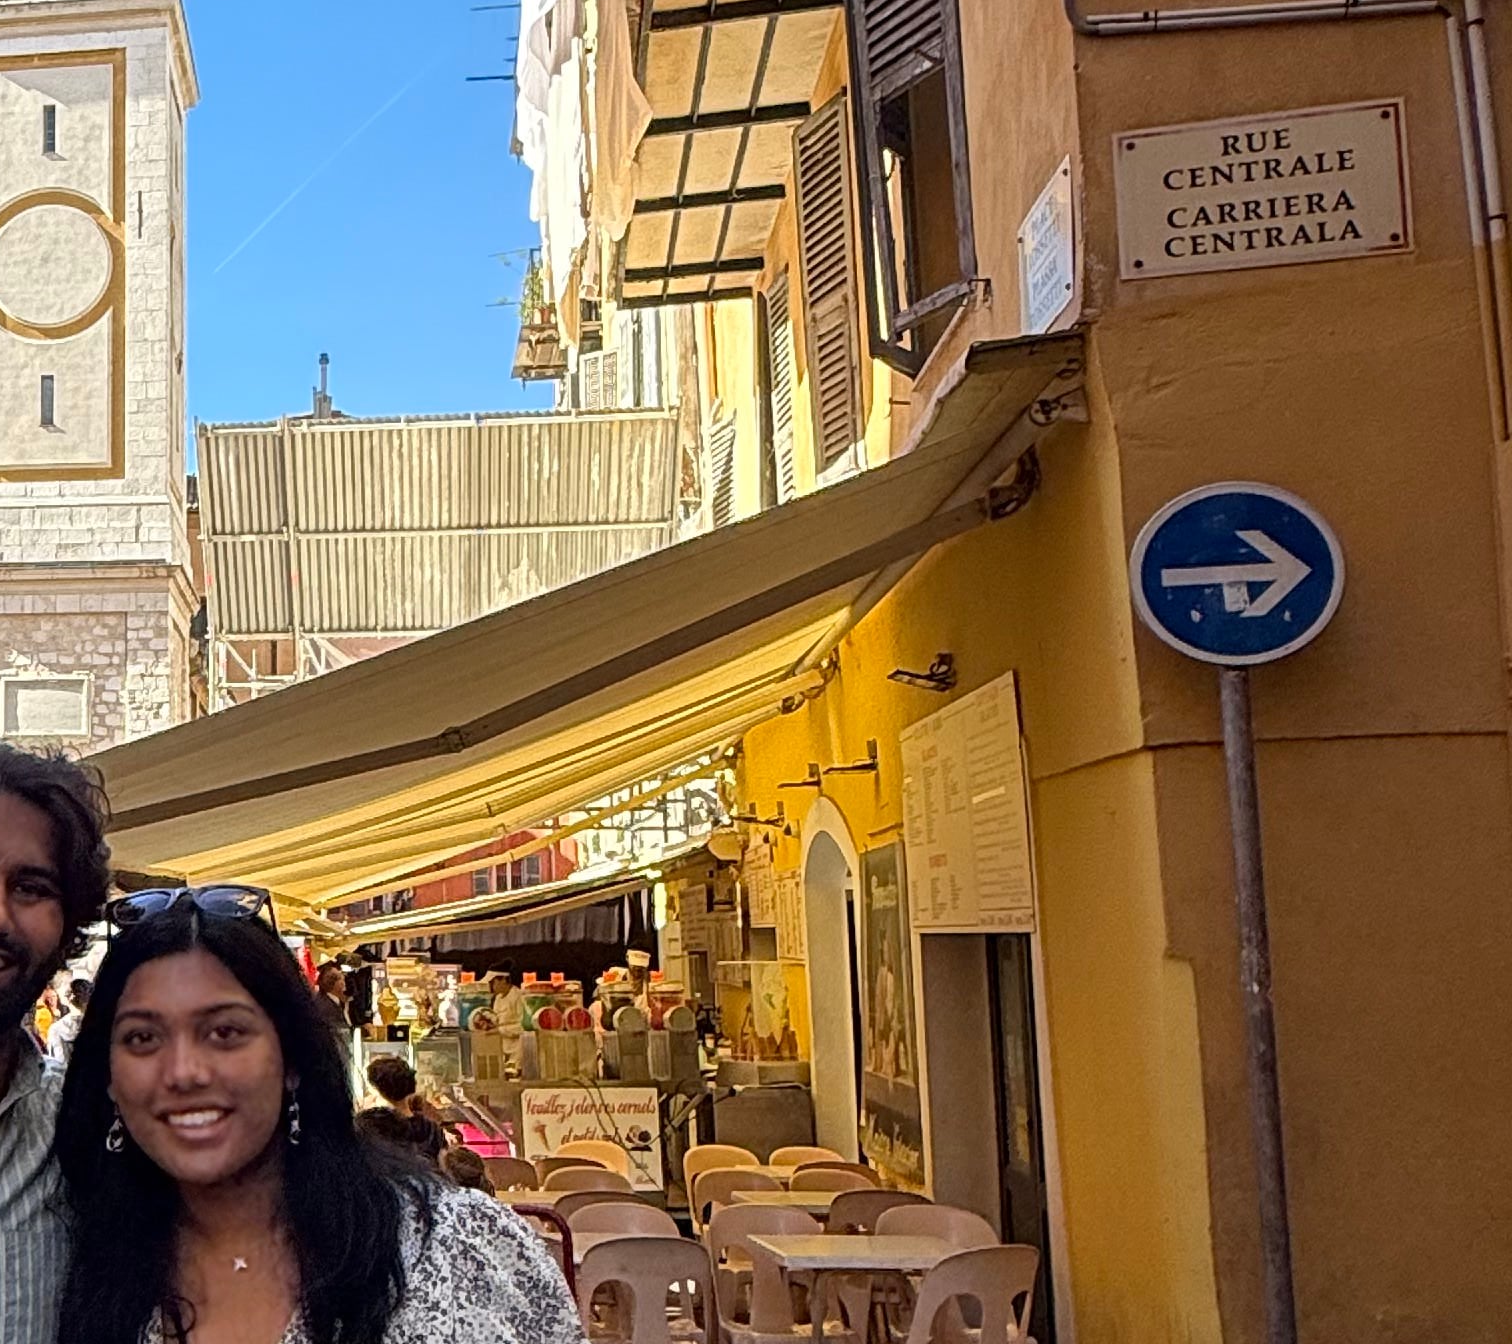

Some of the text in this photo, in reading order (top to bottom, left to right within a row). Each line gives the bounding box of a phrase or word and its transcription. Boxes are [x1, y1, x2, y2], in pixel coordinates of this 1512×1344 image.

[1221, 128, 1291, 156] RUE
[1163, 149, 1355, 191] CENTRALE
[1167, 189, 1357, 229] CARRIERA
[1164, 219, 1363, 258] CENTRALA
